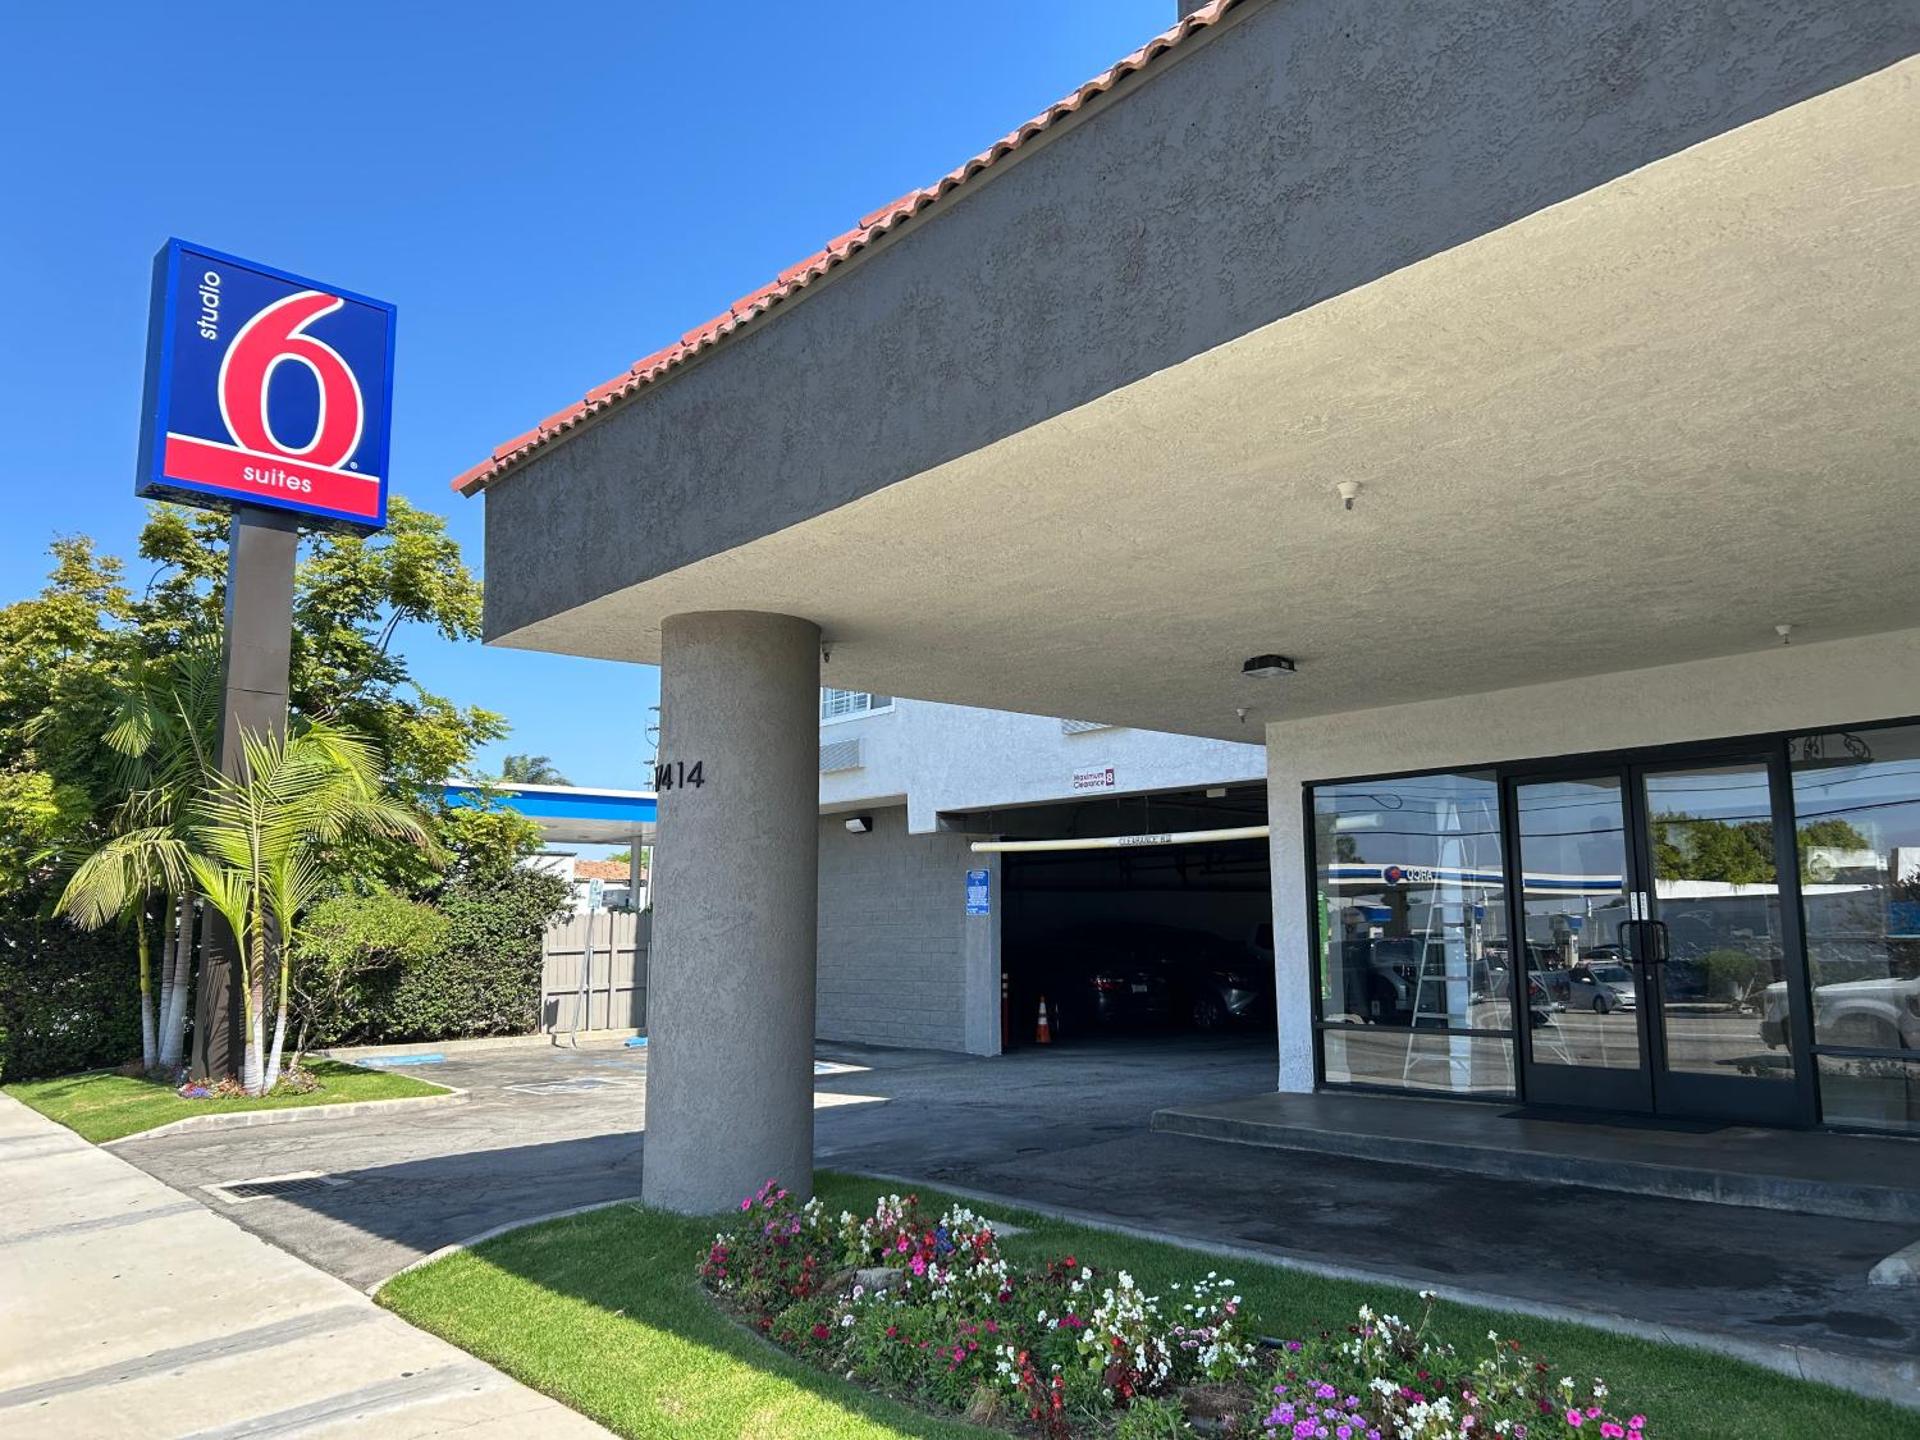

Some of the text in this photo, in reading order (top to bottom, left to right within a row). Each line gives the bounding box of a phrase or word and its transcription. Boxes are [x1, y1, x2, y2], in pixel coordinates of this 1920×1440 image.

[197, 270, 221, 340] studio
[218, 290, 364, 471] 6
[243, 465, 312, 493] suites
